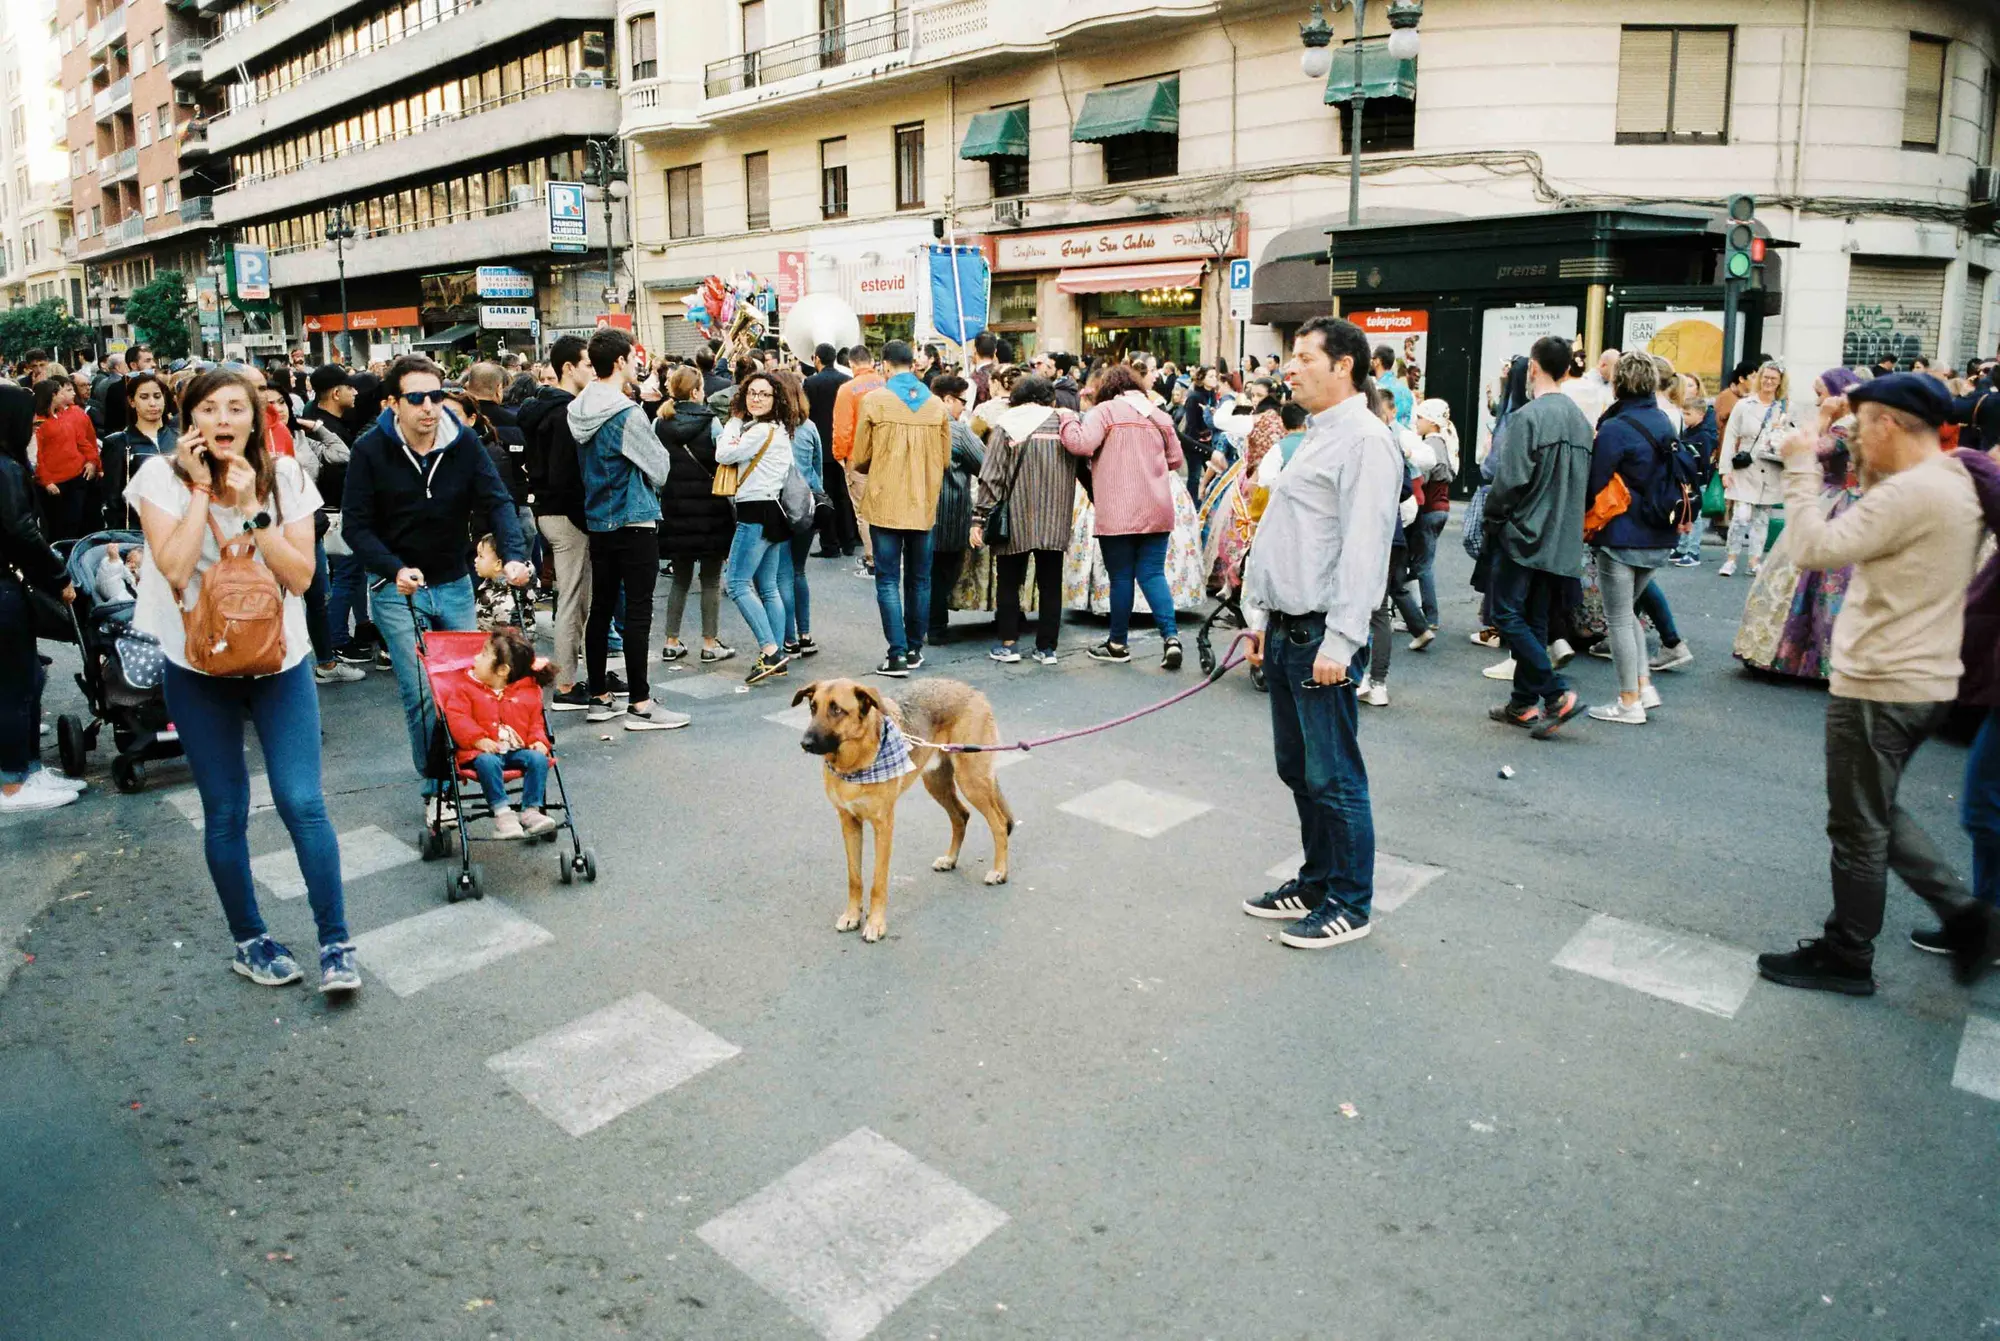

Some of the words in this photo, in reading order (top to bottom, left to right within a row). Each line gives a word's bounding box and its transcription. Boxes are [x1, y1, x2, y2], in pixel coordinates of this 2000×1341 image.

[555, 188, 575, 214] P
[553, 227, 584, 235] CLIENTES
[1097, 236, 1118, 252] San
[240, 254, 263, 284] P
[1234, 264, 1247, 286] P
[1497, 264, 1548, 279] prensa
[861, 275, 905, 292] estevid
[489, 306, 528, 315] GARAJE
[1366, 315, 1412, 331] telepizza
[1631, 322, 1653, 331] SAN
[1631, 331, 1653, 340] SAN
